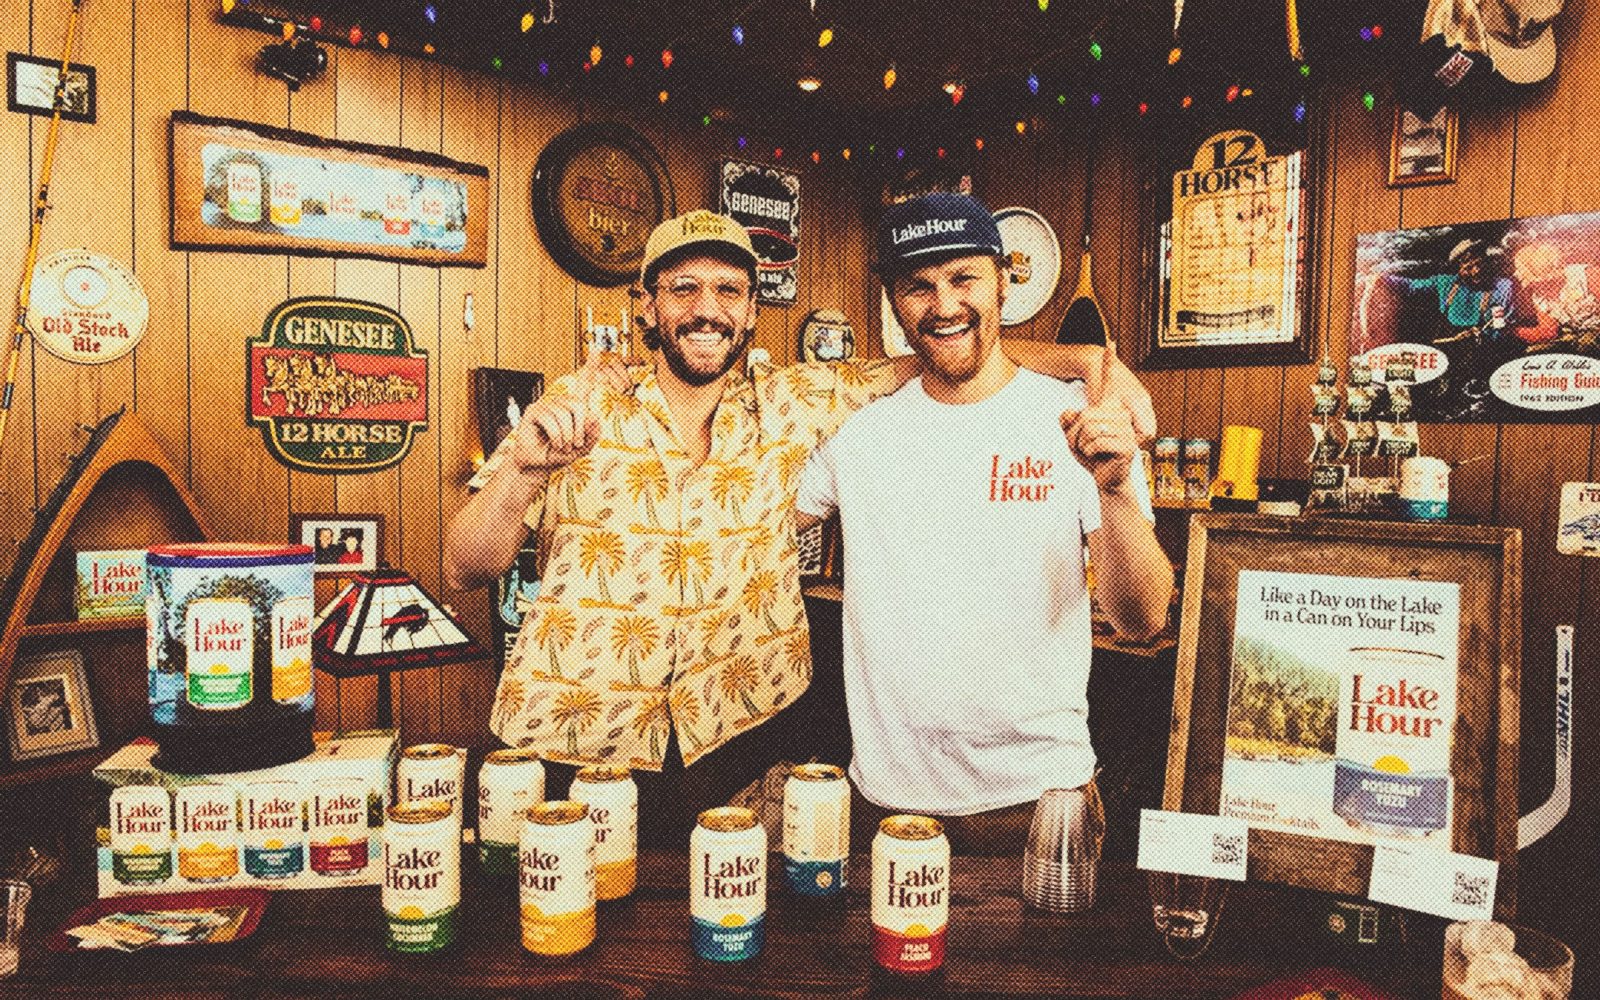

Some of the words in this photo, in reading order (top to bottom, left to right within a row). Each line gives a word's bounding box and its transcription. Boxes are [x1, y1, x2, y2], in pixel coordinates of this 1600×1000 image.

[1209, 135, 1257, 170] 12
[43, 317, 72, 334] Old
[78, 319, 129, 340] Stock
[285, 316, 396, 350] GENESEE
[73, 336, 101, 353] Ale
[1520, 372, 1569, 391] Fishing
[281, 423, 309, 443] 12
[311, 423, 403, 444] HORSE
[321, 446, 367, 460] ALE
[991, 454, 1054, 479] Lake
[989, 478, 1055, 502] Hour
[93, 561, 142, 578] Lake
[93, 578, 144, 595] Hour
[1260, 587, 1293, 605] Like
[1296, 593, 1307, 606] a
[1309, 590, 1342, 611] Day
[1344, 596, 1366, 610] on
[1368, 595, 1397, 612] the
[1400, 597, 1442, 615] Lake
[194, 618, 244, 636] Lake
[1264, 604, 1280, 621] in
[1283, 610, 1294, 623] a
[1296, 608, 1328, 625] Can
[1331, 613, 1353, 627] on
[1356, 612, 1397, 630] Your
[1400, 615, 1437, 635] Lips
[194, 634, 247, 652] Hour
[1351, 674, 1439, 712] Lake
[1349, 704, 1442, 739] Hour
[408, 777, 455, 802] Lake
[1361, 779, 1424, 797] ROSEMARY
[116, 801, 165, 820] Lake
[182, 800, 230, 819] Lake
[249, 797, 297, 816] Lake
[315, 795, 362, 814] Lake
[116, 818, 166, 835] Hour
[182, 816, 233, 834] Hour
[249, 813, 299, 831] Hour
[315, 811, 364, 828] Hour
[385, 843, 441, 871] Lake
[521, 848, 560, 872] ake
[703, 852, 761, 879] Lake
[385, 866, 445, 891] Hour
[889, 860, 945, 888] Lake
[703, 874, 762, 900] Hour
[888, 883, 946, 909] Hour
